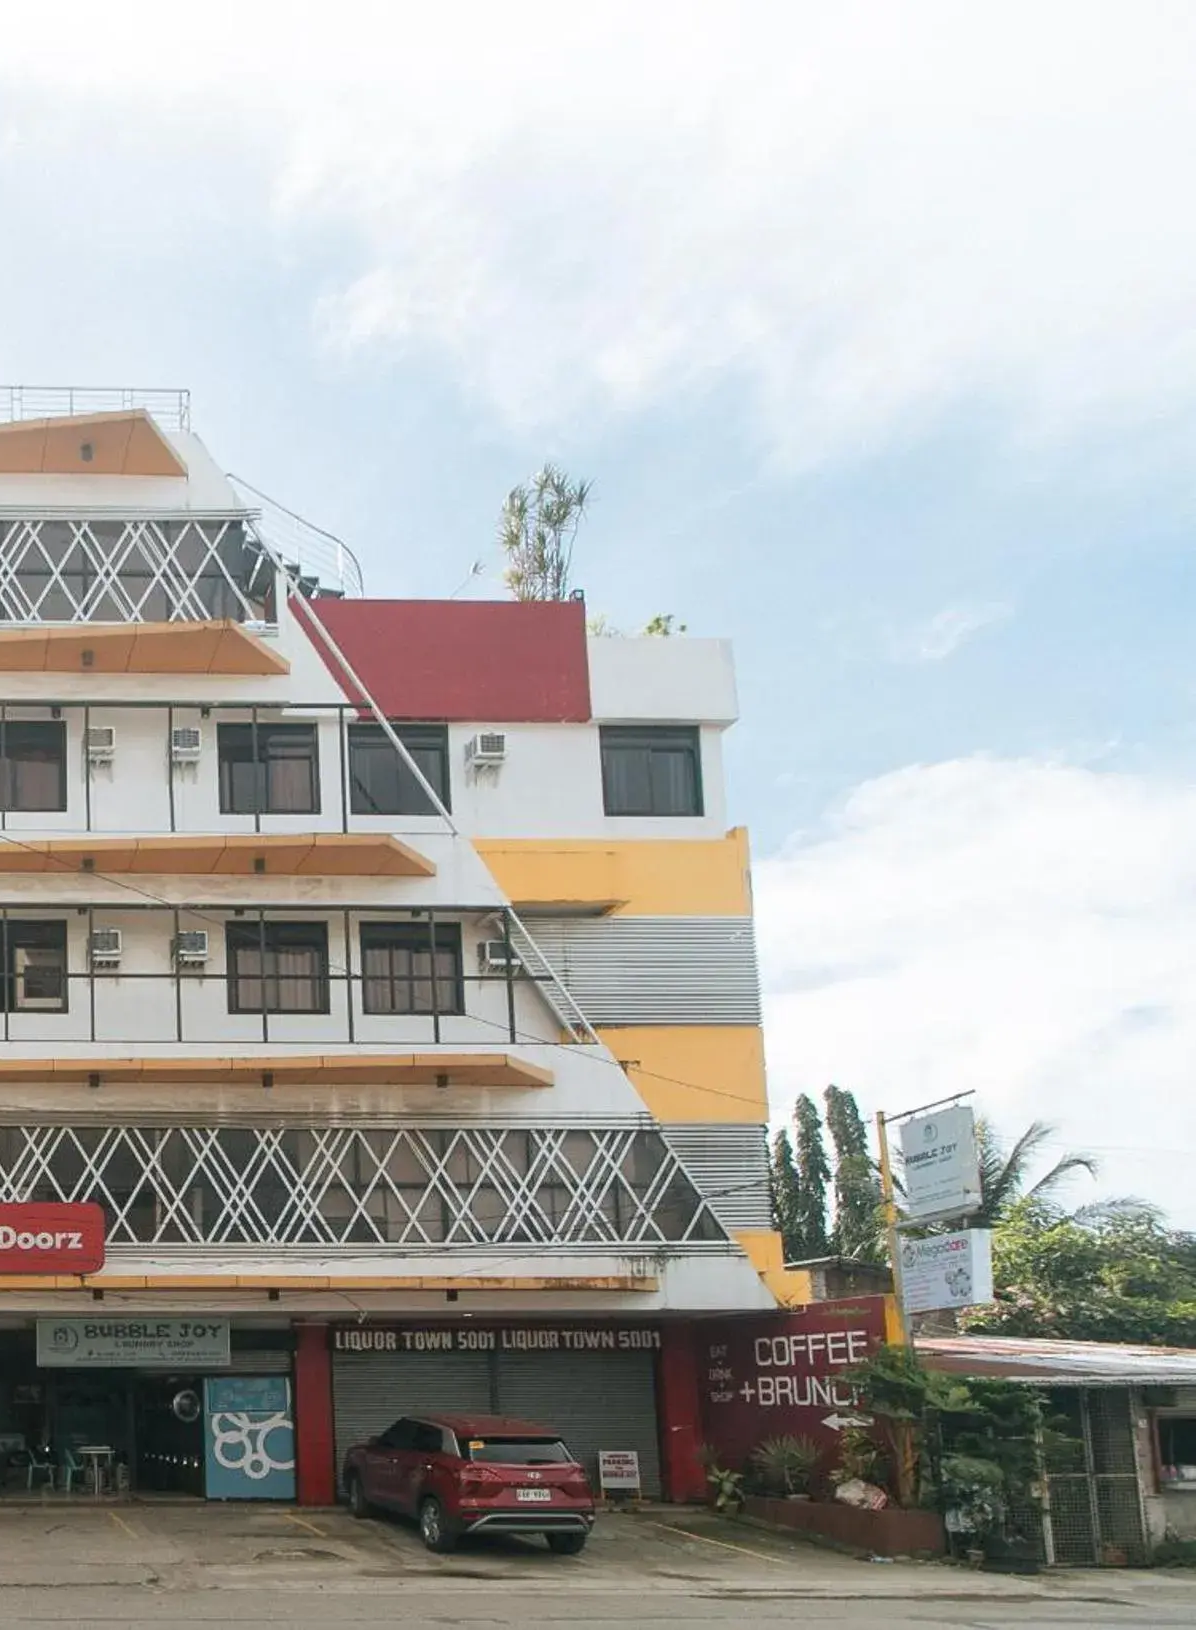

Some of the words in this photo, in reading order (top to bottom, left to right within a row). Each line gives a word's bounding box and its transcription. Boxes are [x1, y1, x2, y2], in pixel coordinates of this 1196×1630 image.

[84, 1324, 171, 1339] BUBBLE
[179, 1324, 222, 1338] JOY
[335, 1331, 397, 1350] LIQUOR
[402, 1331, 452, 1349] TOWN
[457, 1331, 495, 1349] 5001
[502, 1330, 559, 1349] LIQUOR
[561, 1331, 614, 1349] TOWN
[618, 1331, 661, 1348] 5001
[755, 1330, 868, 1366] COFFEE
